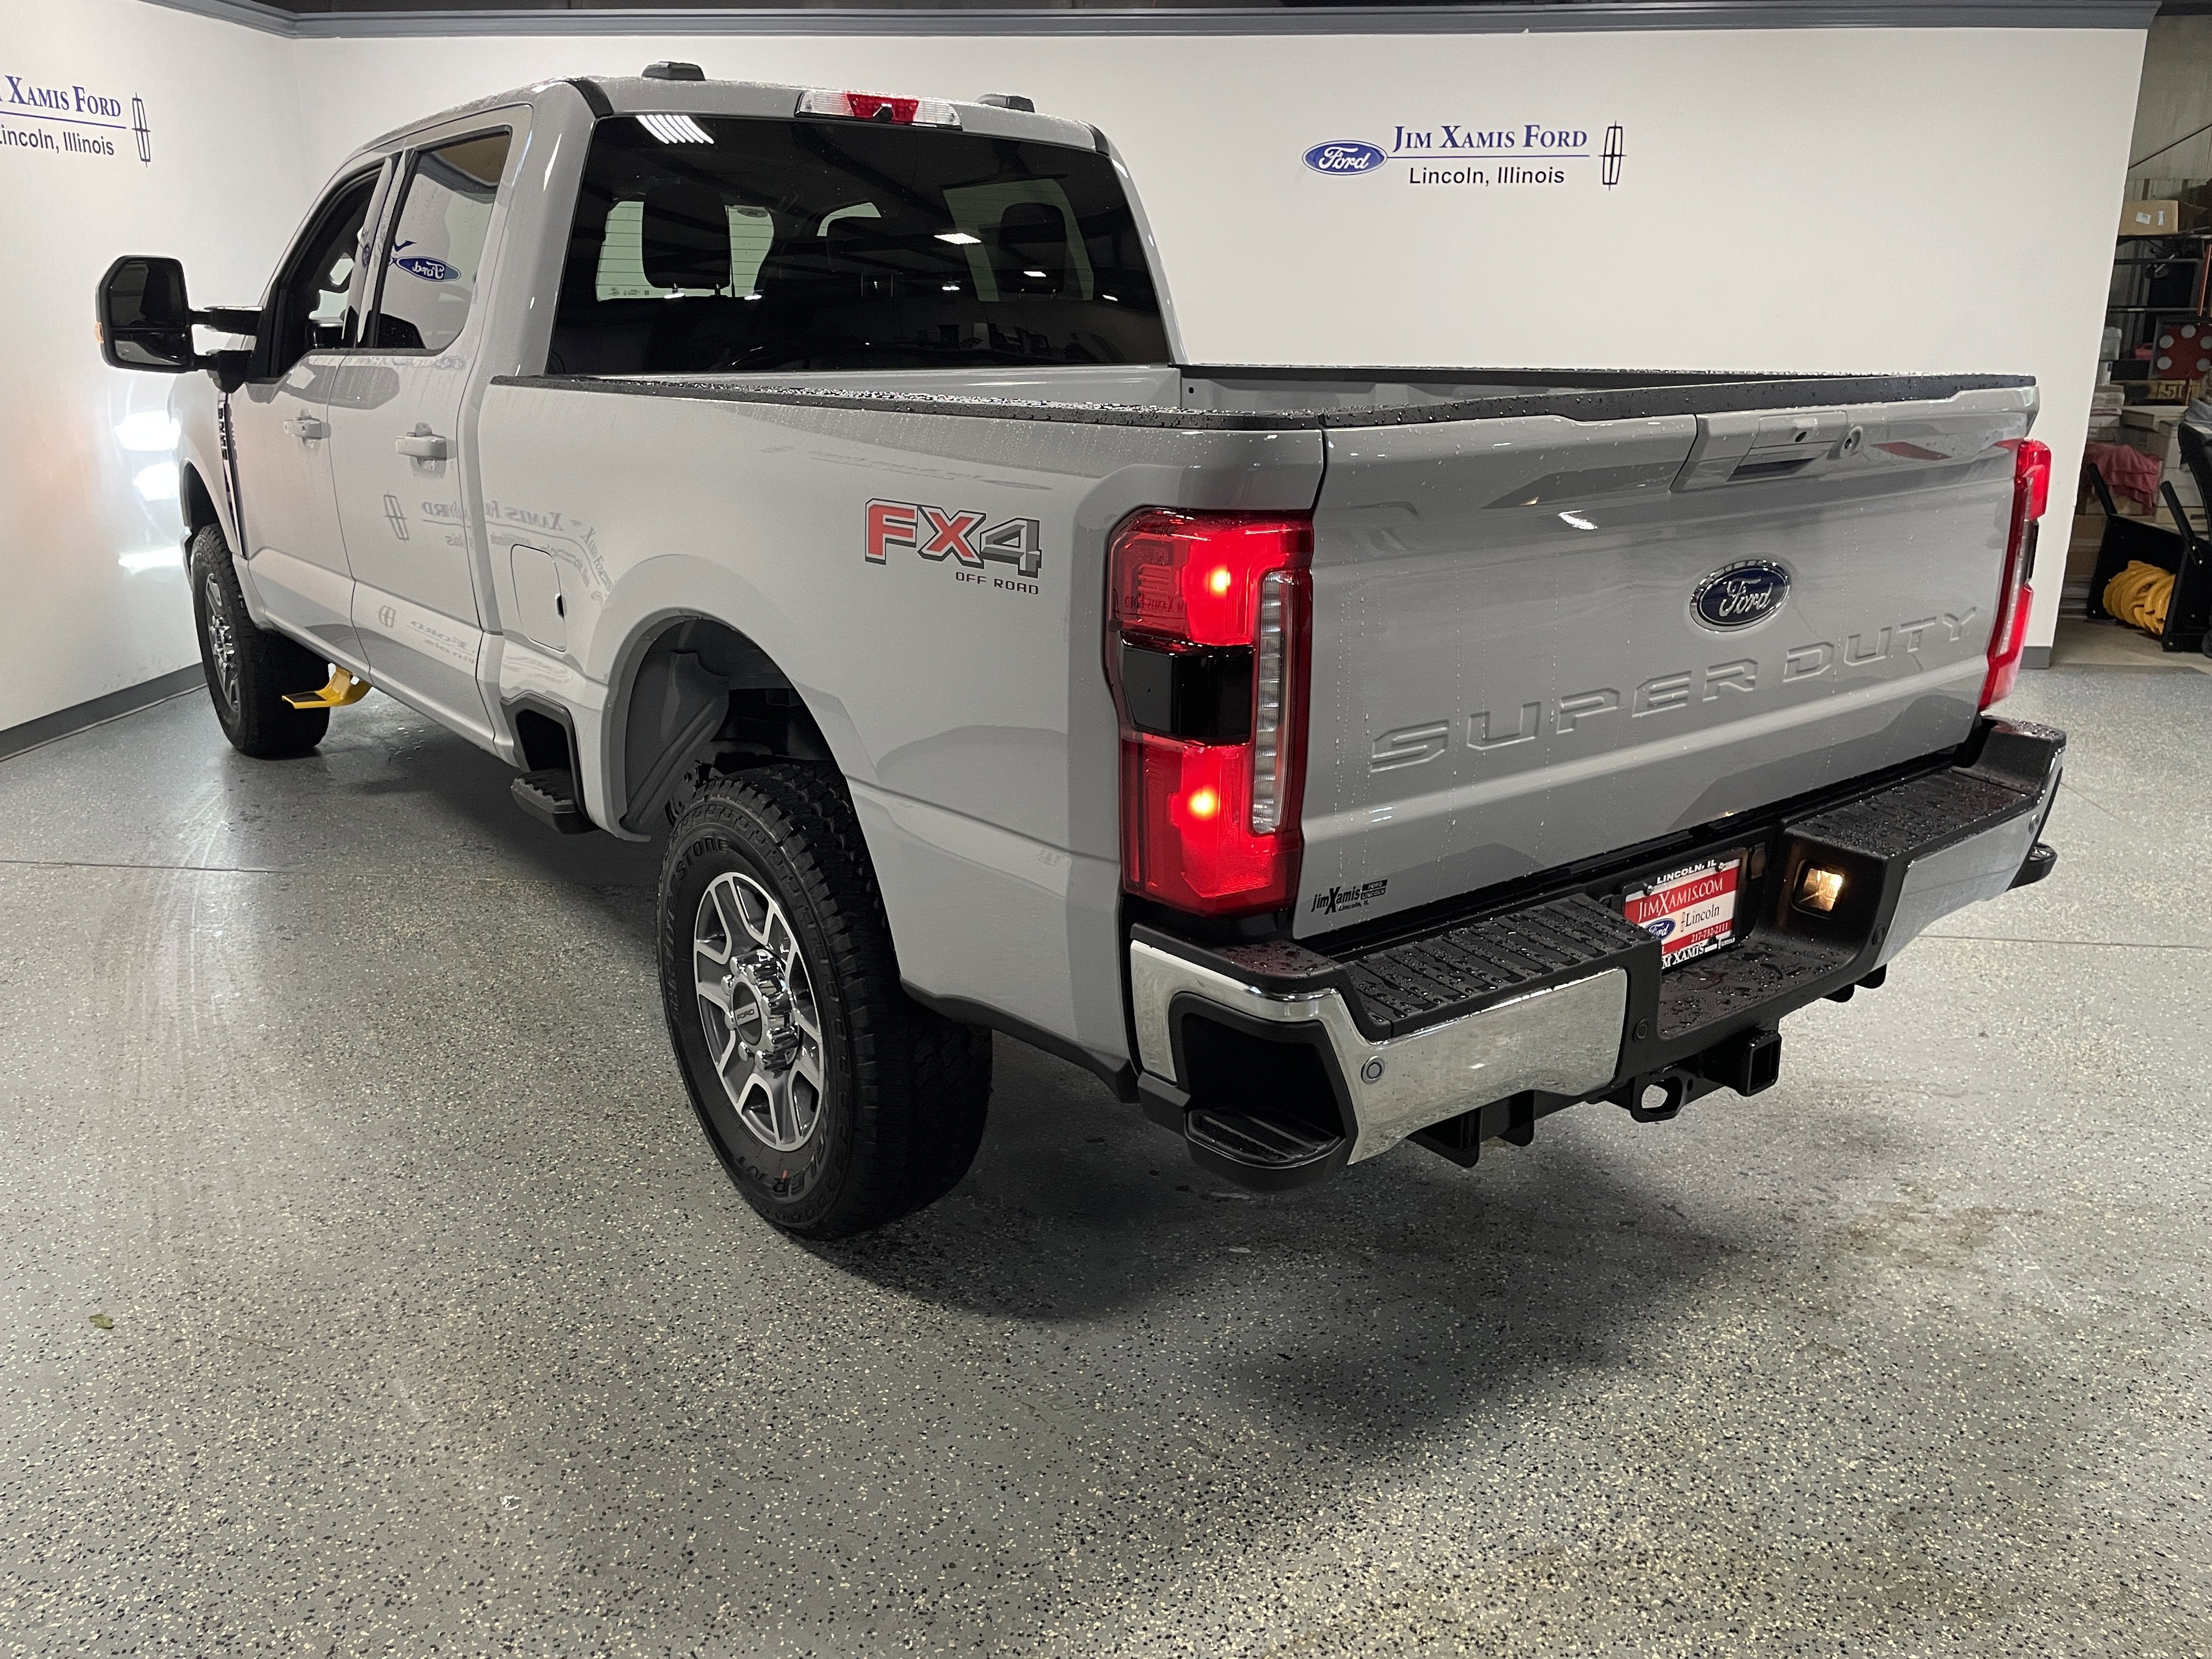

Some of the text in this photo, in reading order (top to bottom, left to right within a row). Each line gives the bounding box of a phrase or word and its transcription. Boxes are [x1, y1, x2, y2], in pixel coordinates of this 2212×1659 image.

[5, 75, 121, 117] XAMIS FORD
[63, 131, 114, 156] Illinois
[1392, 125, 1587, 152] JIM XAMIS FORD
[1318, 146, 1369, 170] Ford
[1409, 167, 1565, 187] Lincoln, Illinois
[865, 498, 1041, 578] FX4
[956, 572, 1039, 595] OFF ROAD
[1719, 575, 1773, 618] Ford
[1370, 606, 1977, 774] SUPER DUTY
[1656, 863, 1705, 884] LINCOLN,
[1638, 877, 1723, 923] JIMXAMIS.COM
[1685, 904, 1719, 927] Lincoln
[1691, 922, 1728, 943] 217-732-2111
[1673, 943, 1705, 965] XAMIS
[737, 1008, 755, 1019] FORD
